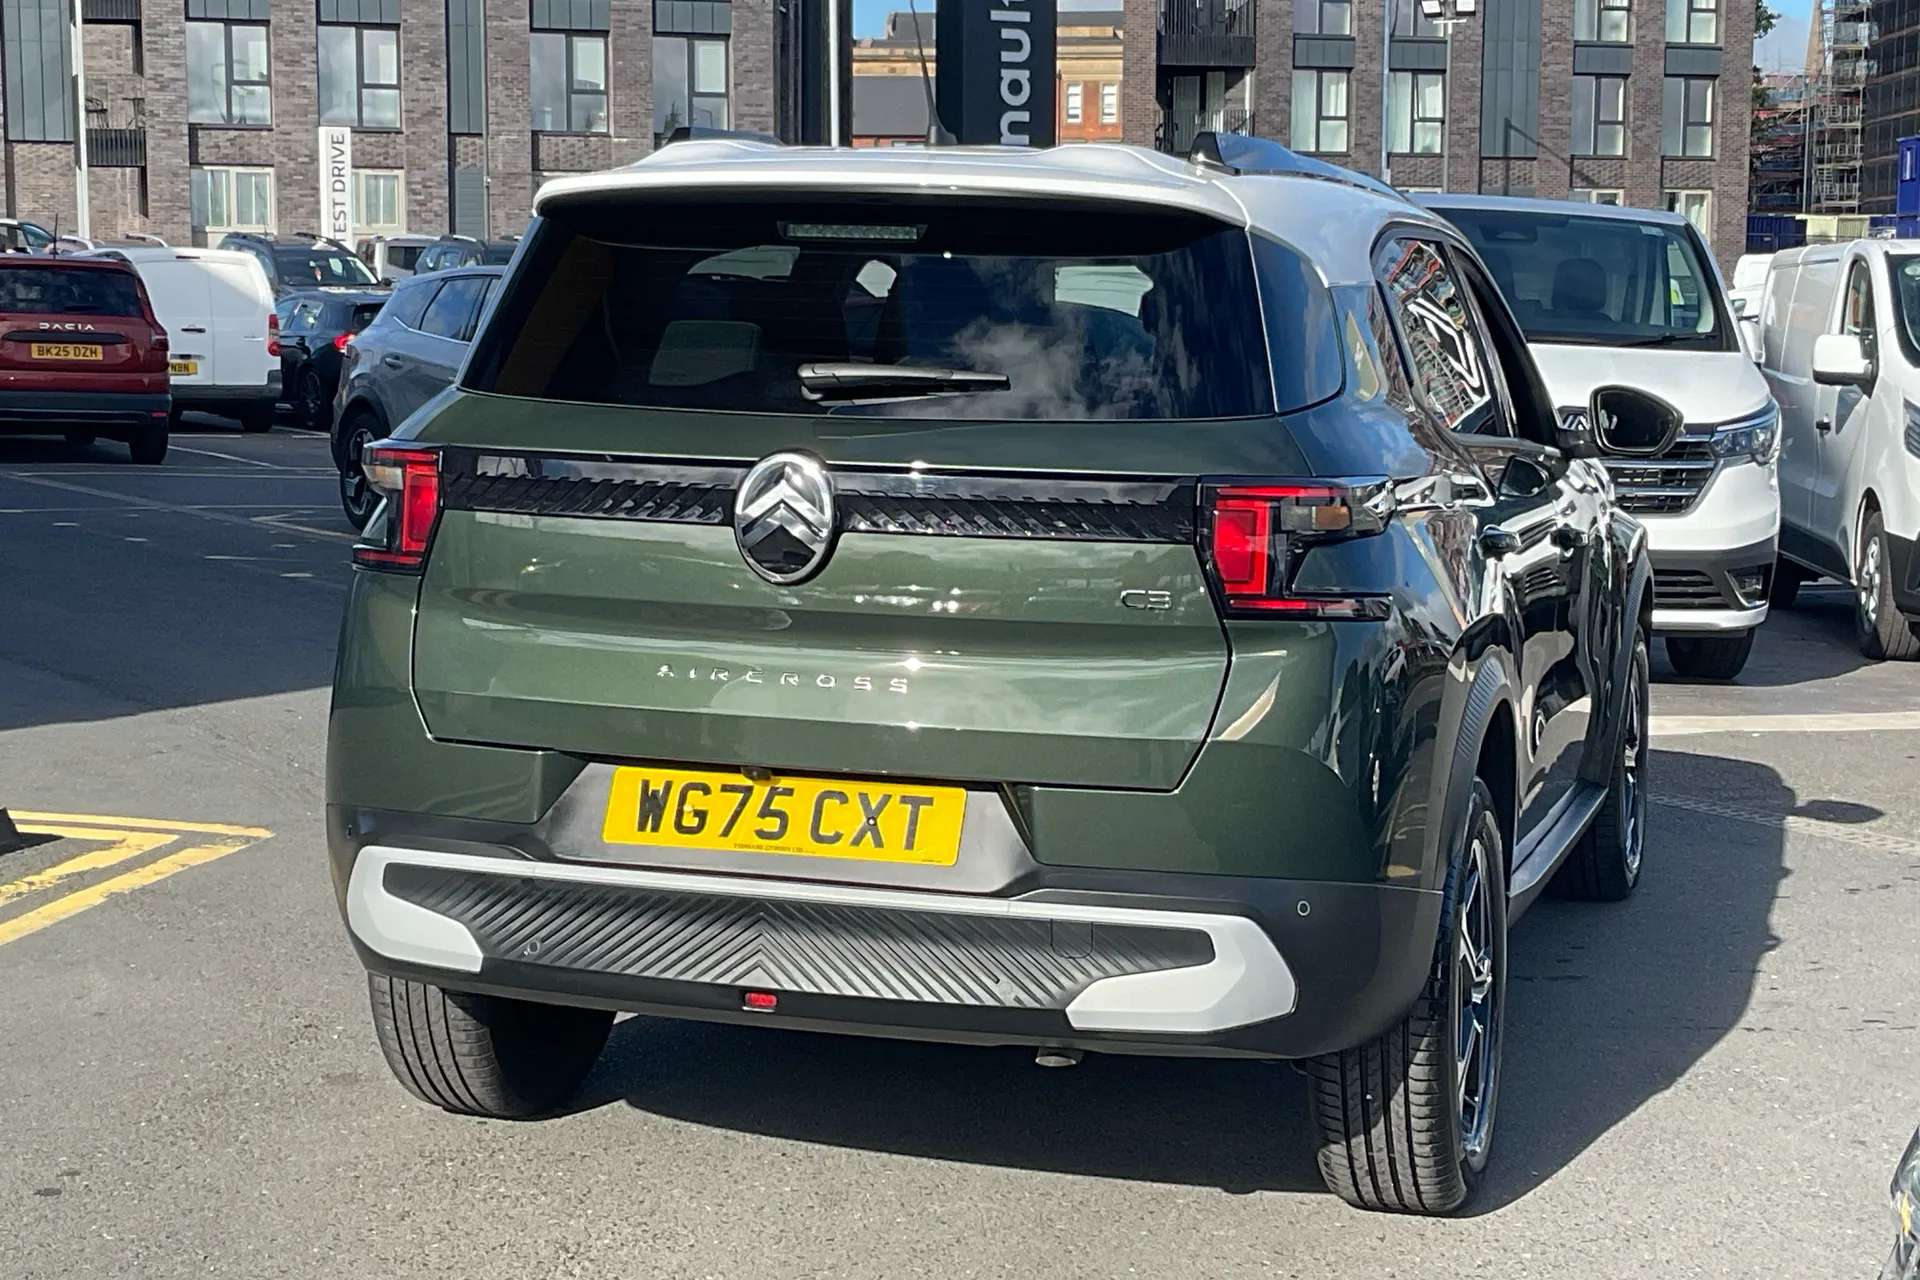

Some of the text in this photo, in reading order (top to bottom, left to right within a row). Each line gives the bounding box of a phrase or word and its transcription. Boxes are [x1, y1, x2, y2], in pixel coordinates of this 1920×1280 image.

[331, 133, 346, 193] DRIVE
[39, 322, 95, 331] DACIA
[37, 345, 70, 357] BK25
[1120, 589, 1172, 610] C3
[656, 664, 909, 694] AIRCROSS
[636, 778, 935, 851] WG75 CXT
